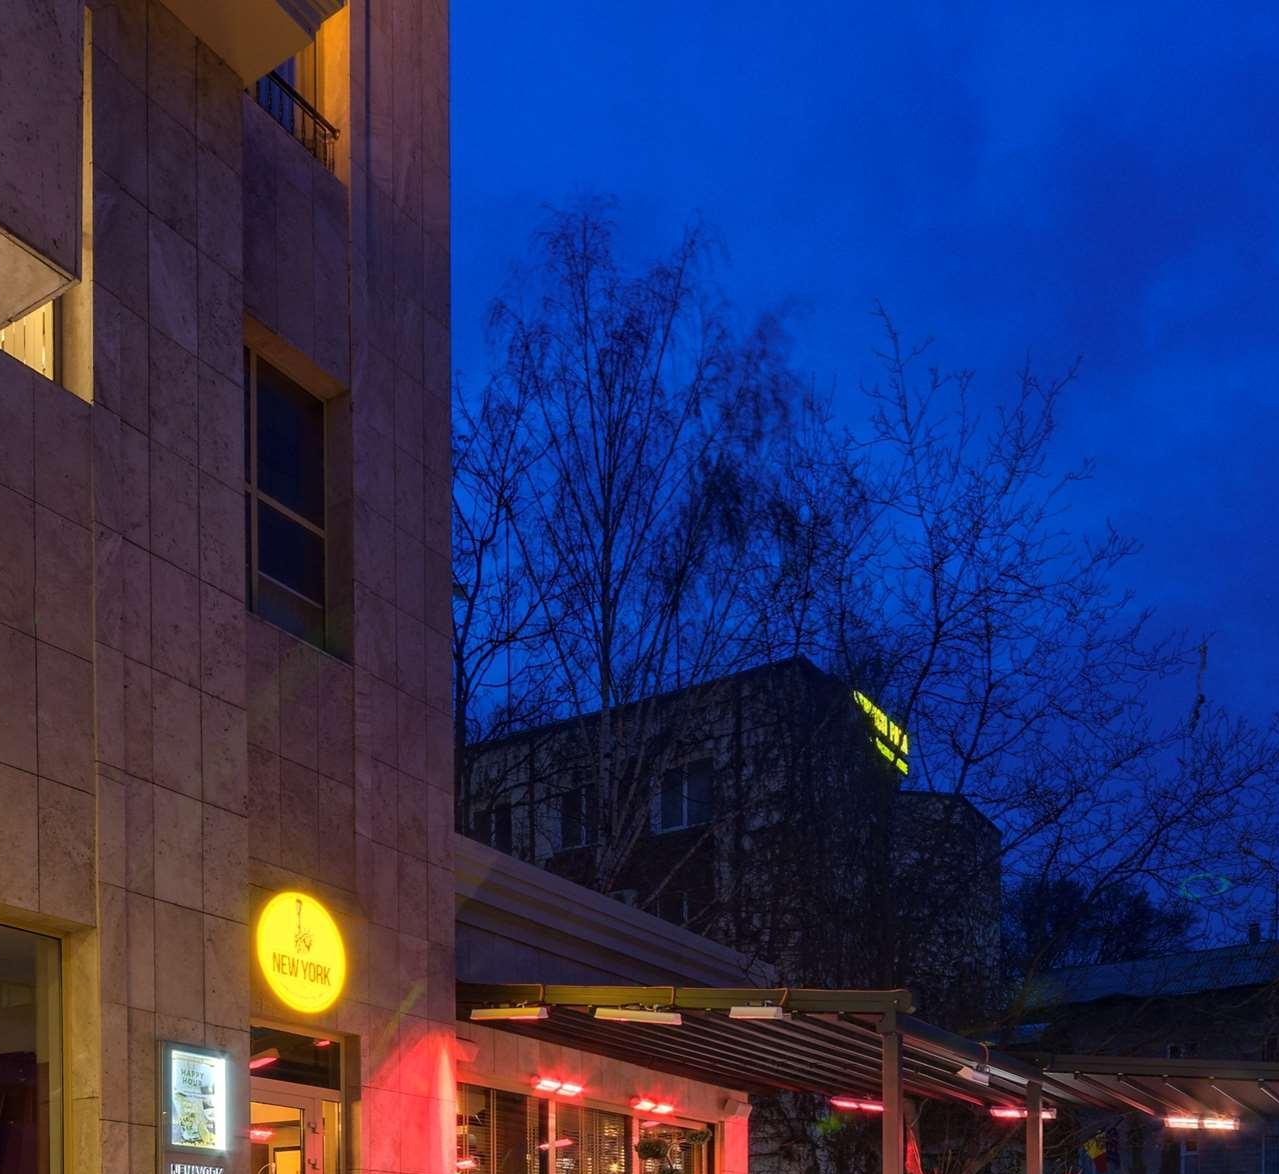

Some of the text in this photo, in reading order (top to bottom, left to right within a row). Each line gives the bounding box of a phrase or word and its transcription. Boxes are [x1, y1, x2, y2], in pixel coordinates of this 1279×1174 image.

[272, 951, 332, 987] NEW YORK
[180, 1068, 205, 1080] HAPPY
